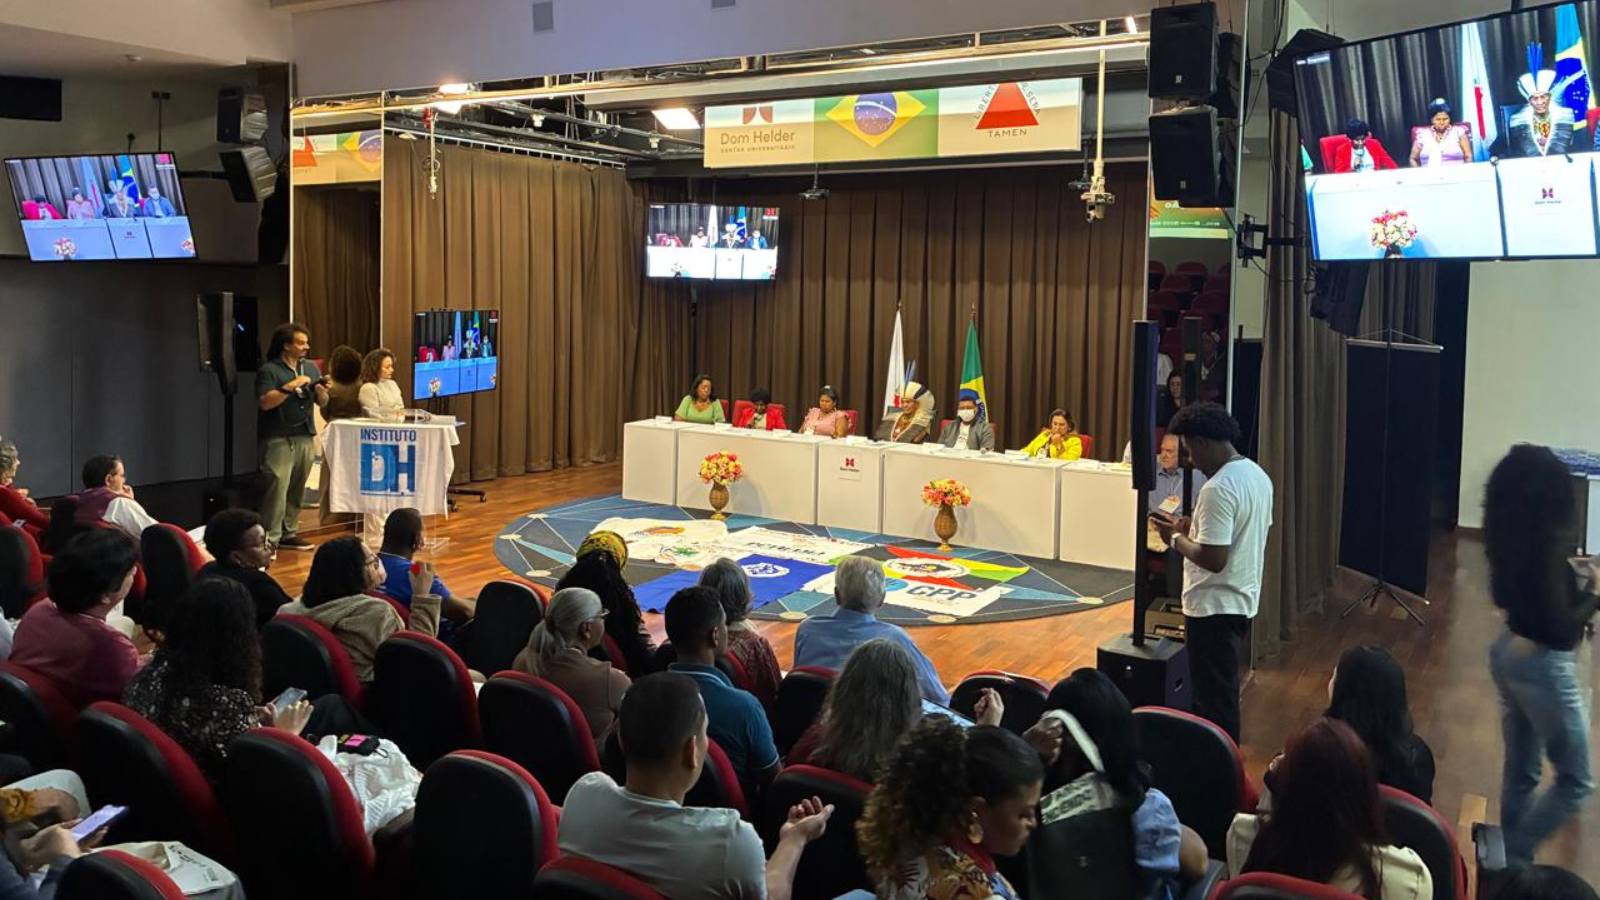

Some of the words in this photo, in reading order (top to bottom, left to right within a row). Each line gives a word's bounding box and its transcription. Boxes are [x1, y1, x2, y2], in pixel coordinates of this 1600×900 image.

[720, 132, 750, 145] Dom
[753, 128, 796, 144] Helder
[988, 128, 1028, 138] TAMEN
[360, 428, 417, 442] INSTITUTO
[906, 584, 977, 601] CPP
